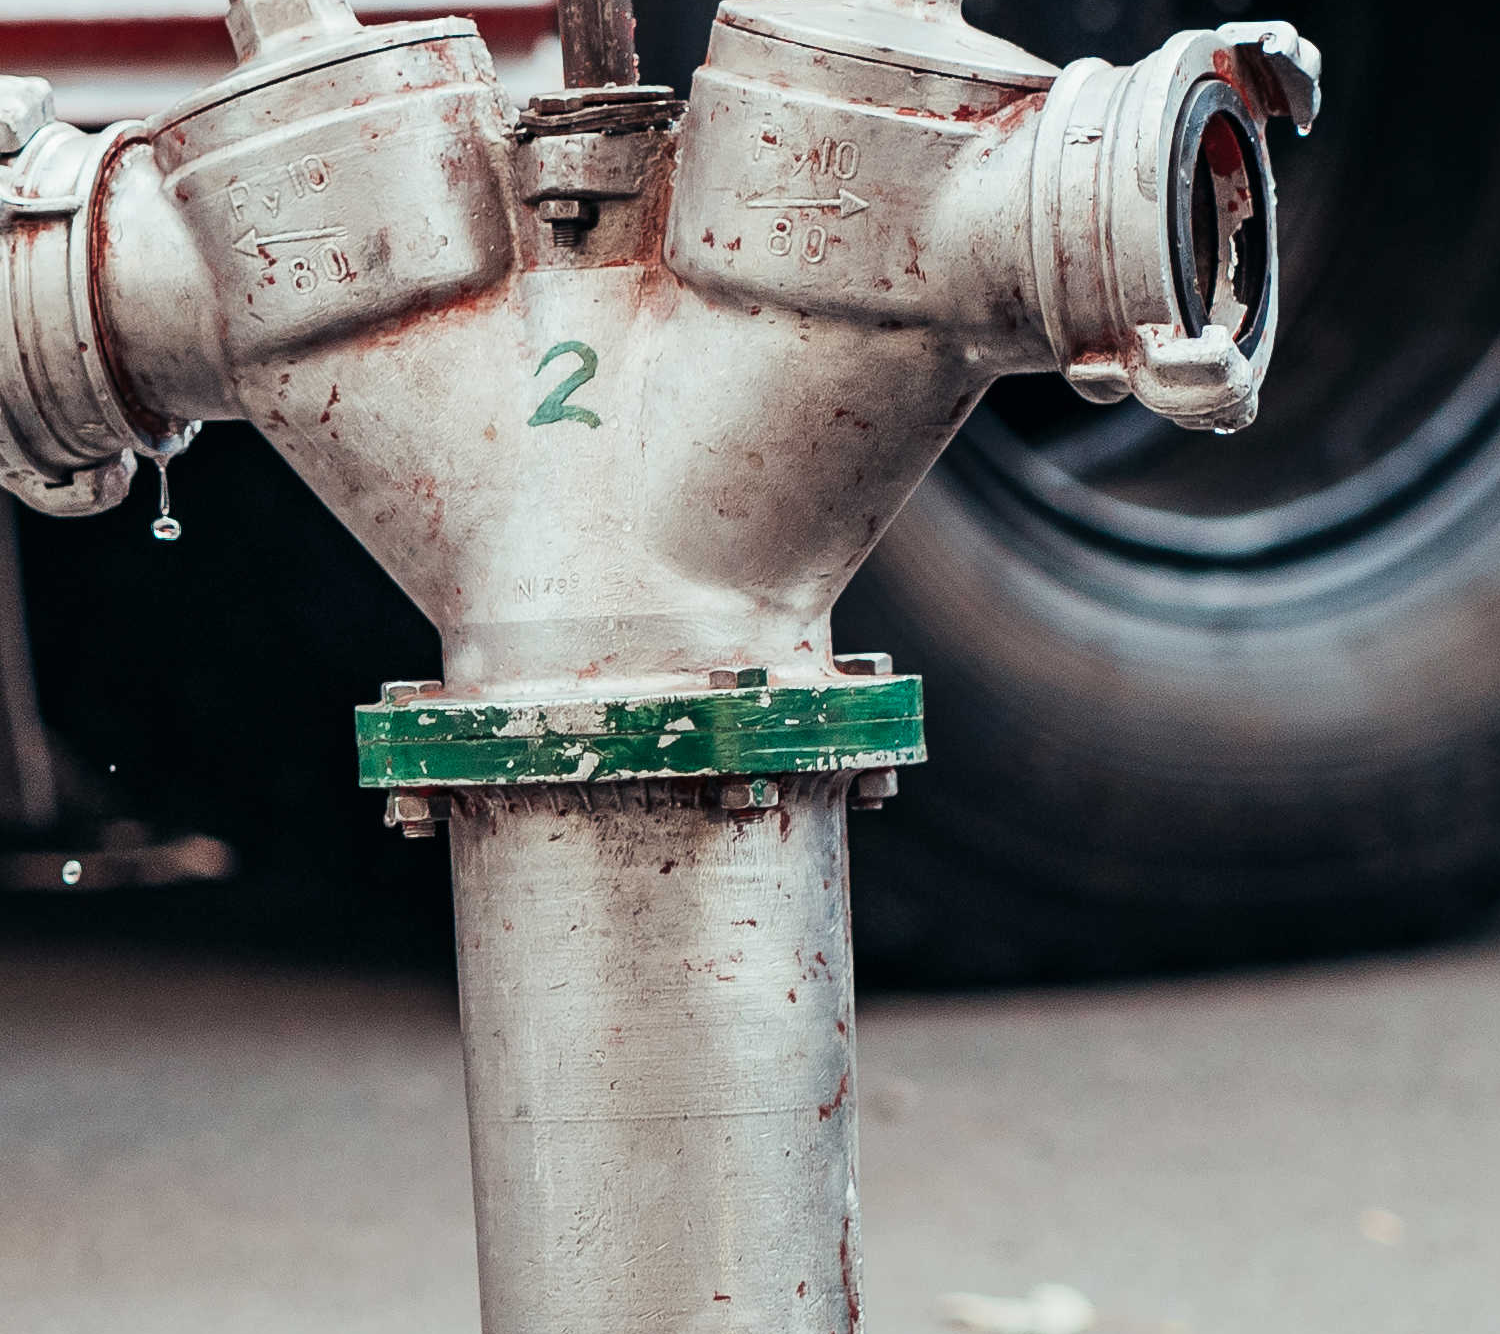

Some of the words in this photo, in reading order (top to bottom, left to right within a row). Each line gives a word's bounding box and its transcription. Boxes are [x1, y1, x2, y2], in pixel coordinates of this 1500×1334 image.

[767, 218, 828, 264] 80
[289, 242, 350, 294] 80
[527, 340, 602, 429] 2
